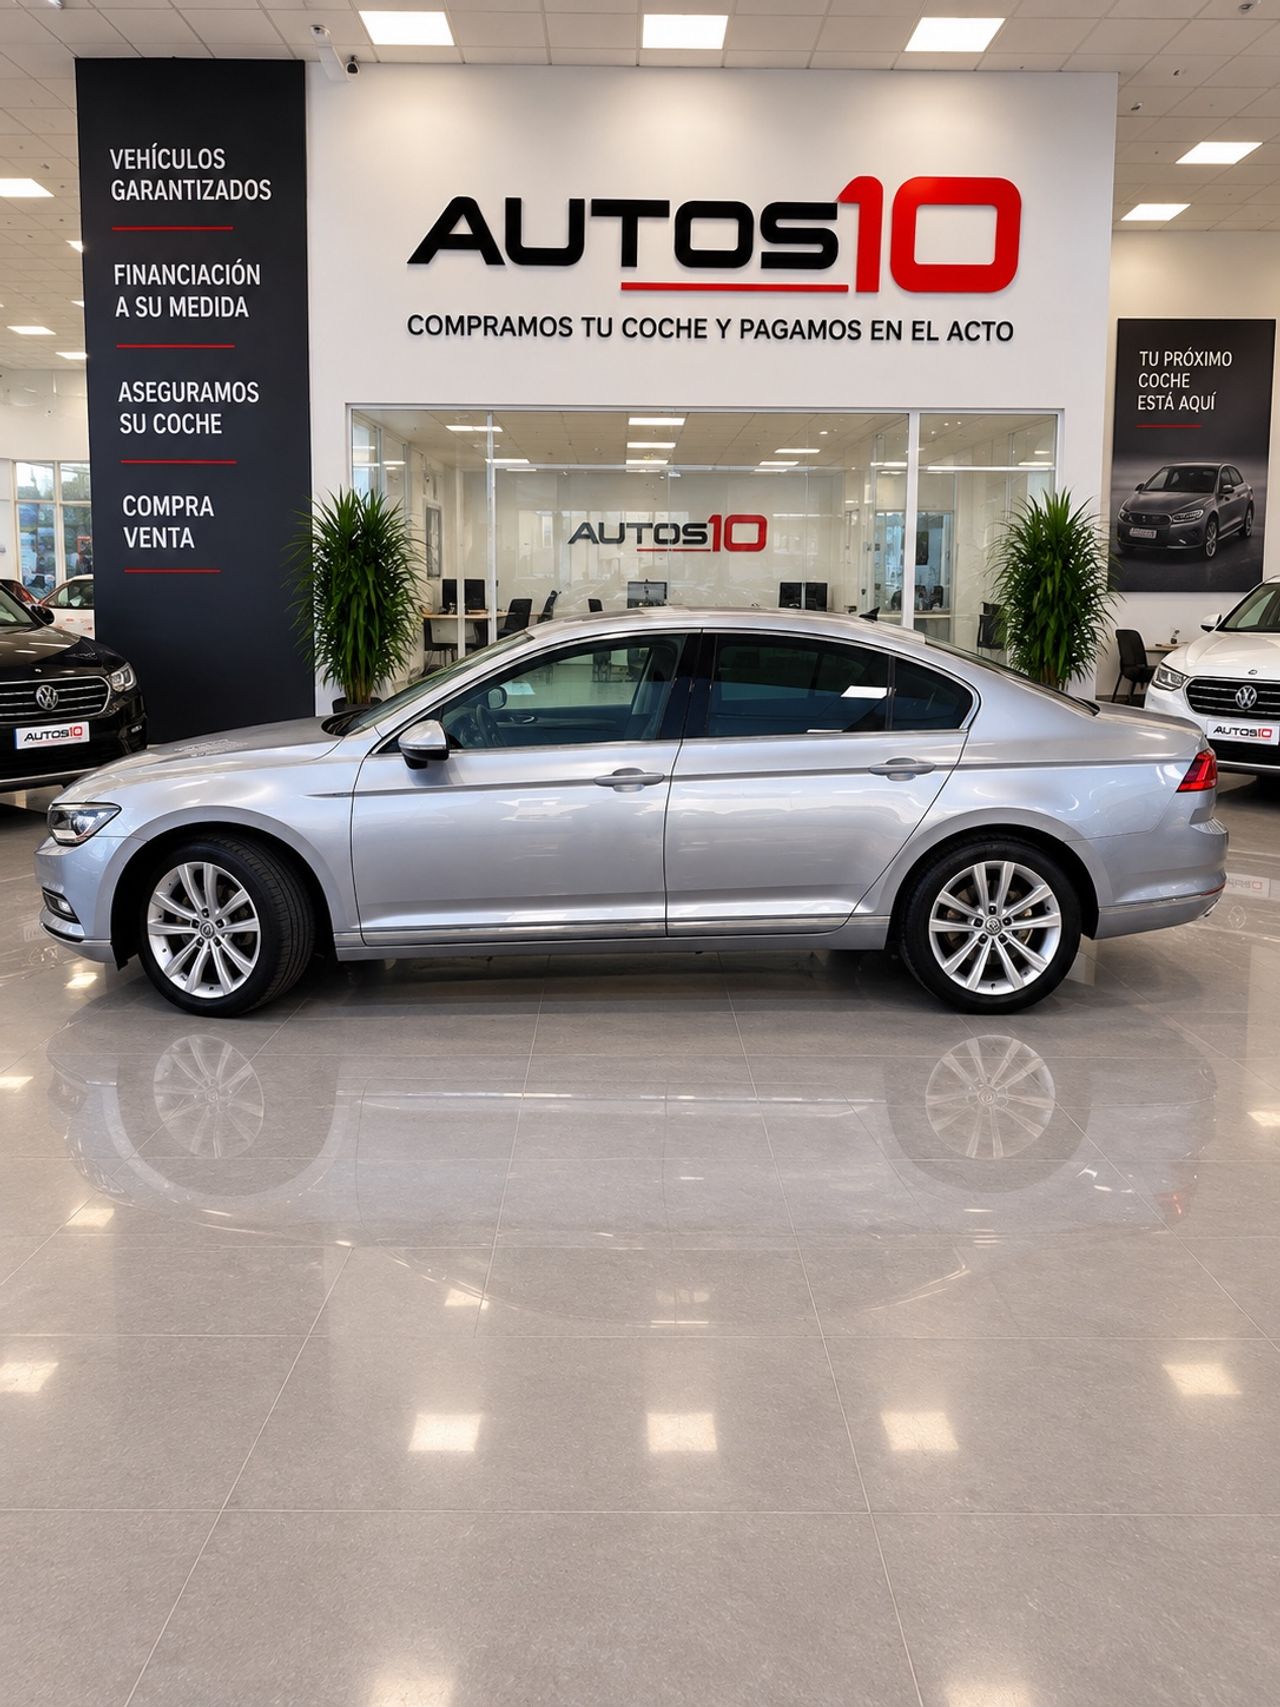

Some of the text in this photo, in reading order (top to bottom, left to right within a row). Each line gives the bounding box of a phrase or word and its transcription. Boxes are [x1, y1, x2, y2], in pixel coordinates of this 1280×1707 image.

[110, 143, 226, 170] VEHÍCULOS
[111, 179, 272, 202] GARANTIZADOS
[407, 176, 1023, 294] AUTOS10
[114, 259, 261, 286] FINANCIACIÓN
[115, 296, 249, 318] A SU MEDIDA
[407, 314, 1014, 343] COMPRAMOS TU COCHE Y PAGAMOS EN EL ACTO
[1139, 347, 1233, 368] TU PRÓXIMO
[1138, 373, 1191, 388] COCHE
[118, 381, 260, 404] ASEGURAMOS
[1137, 391, 1217, 413] ESTÁ AQUÍ
[119, 412, 223, 435] SU COCHE
[122, 494, 215, 518] COMPRA
[123, 526, 195, 549] VENTA
[567, 514, 768, 552] AUTOS10
[24, 726, 83, 741] AUTOS10
[1213, 726, 1272, 738] AUTOS10
